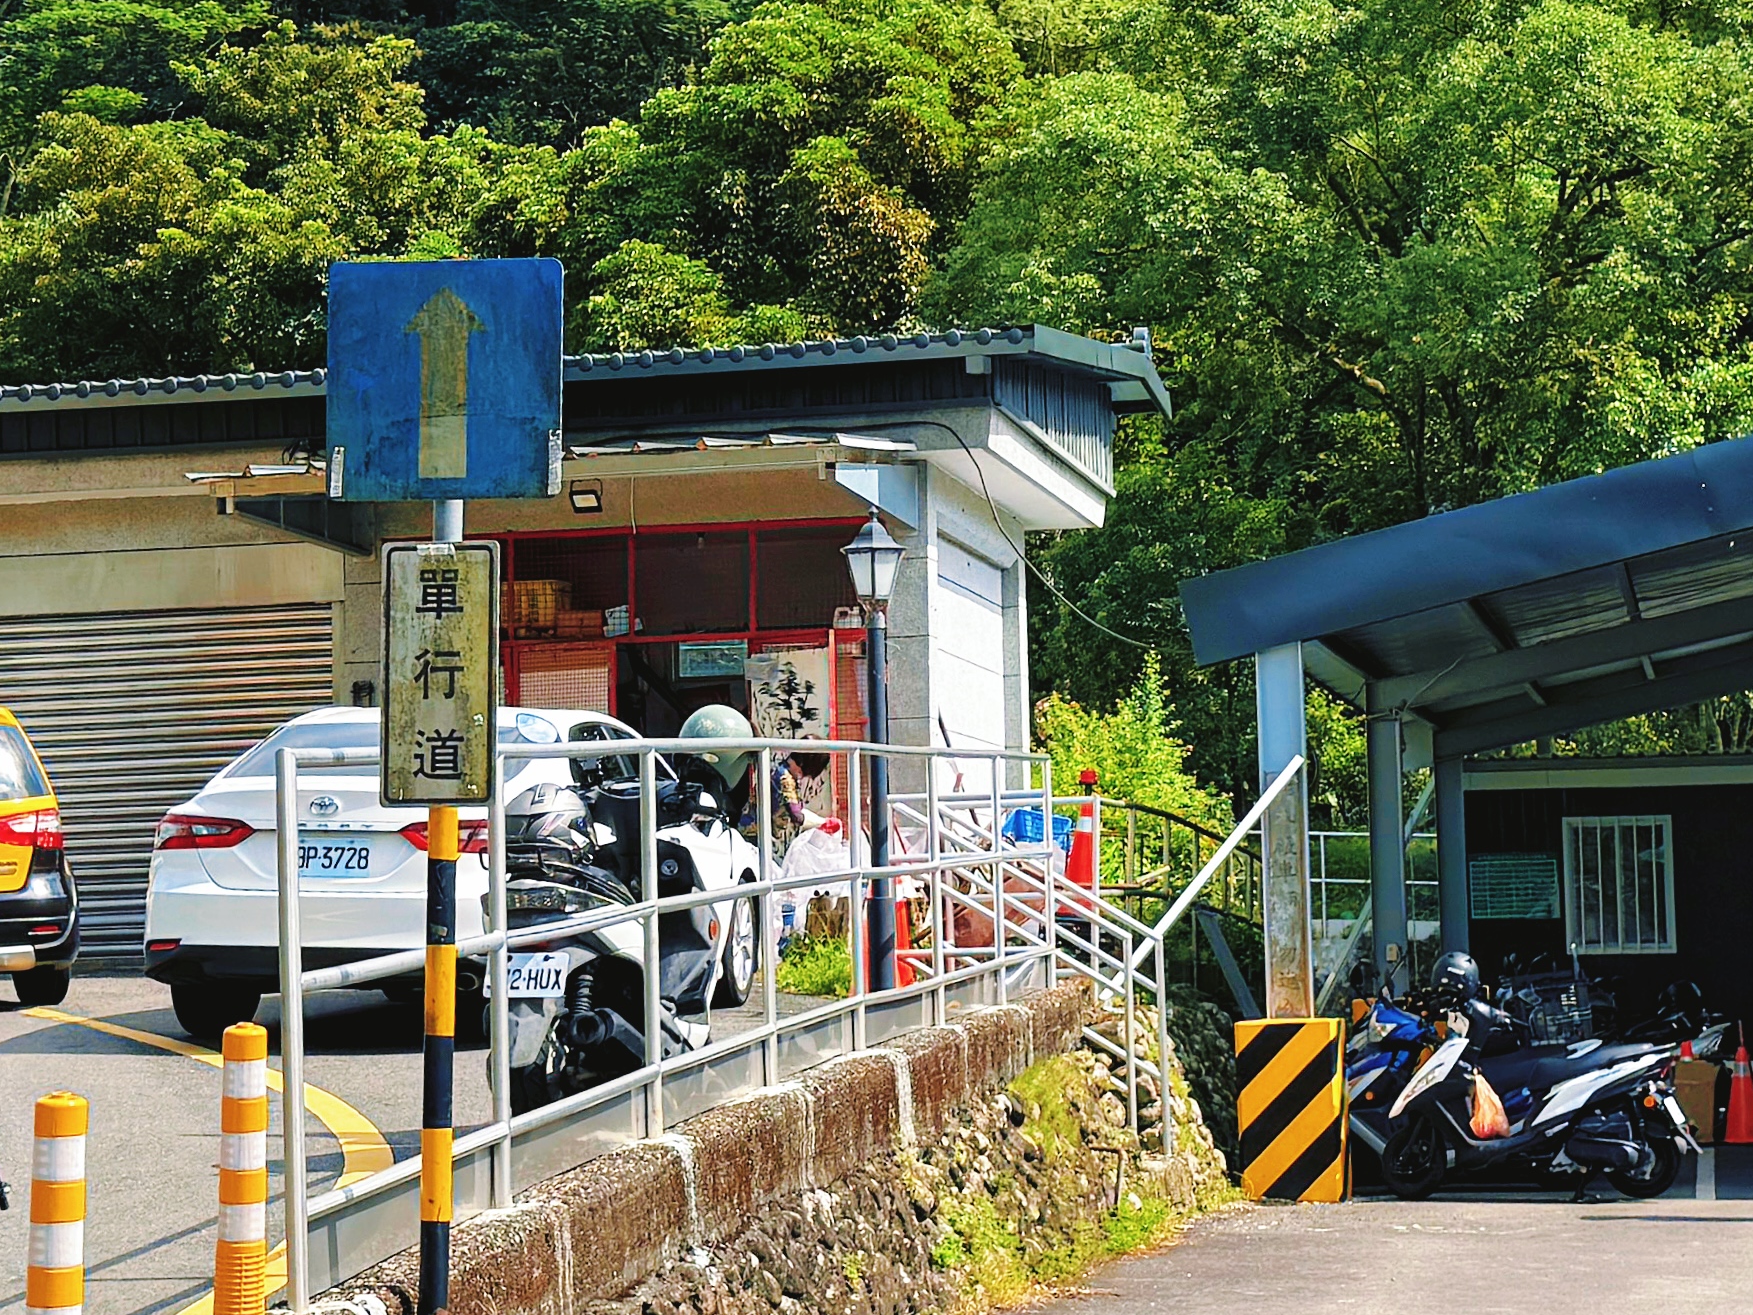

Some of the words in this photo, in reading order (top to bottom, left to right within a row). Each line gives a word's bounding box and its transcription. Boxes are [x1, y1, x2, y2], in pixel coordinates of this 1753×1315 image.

[413, 568, 465, 780] 單行道
[298, 846, 370, 870] BP-3728
[507, 967, 562, 991] 2-HUX
